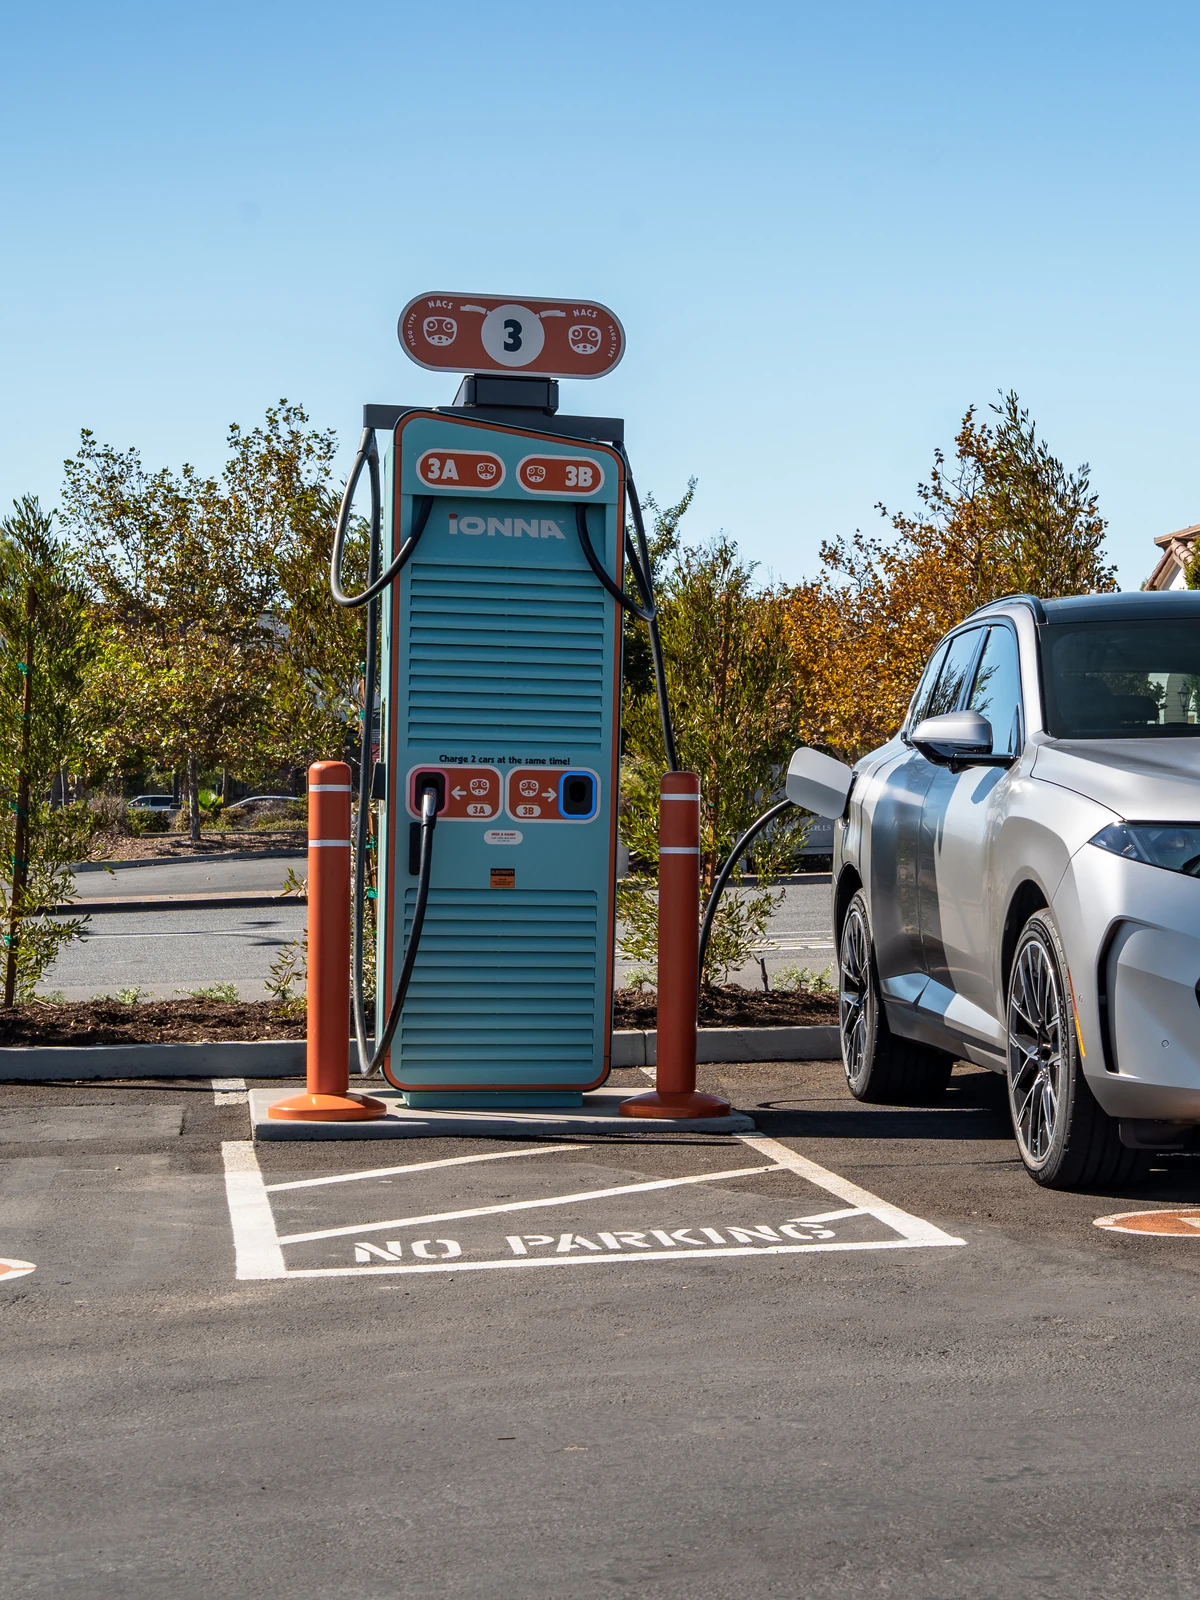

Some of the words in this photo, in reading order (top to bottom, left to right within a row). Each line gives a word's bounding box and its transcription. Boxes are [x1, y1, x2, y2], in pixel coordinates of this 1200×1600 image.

[428, 299, 453, 309] NACS
[408, 313, 417, 328] TYPE
[573, 309, 598, 318] NACS
[407, 330, 416, 346] PLUG
[503, 319, 522, 352] 3
[608, 325, 616, 341] PLUG
[608, 343, 616, 358] TYPE
[427, 457, 459, 481] 3A
[565, 465, 593, 487] 3B
[439, 754, 468, 764] Charge
[471, 755, 476, 763] 2
[478, 756, 495, 764] cars
[497, 756, 506, 764] at
[508, 756, 522, 764] the
[525, 757, 546, 765] same
[549, 757, 571, 765] time!
[472, 806, 485, 814] 3A
[522, 806, 534, 815] 3B
[354, 1239, 462, 1263] NO
[505, 1223, 836, 1254] PARKING
